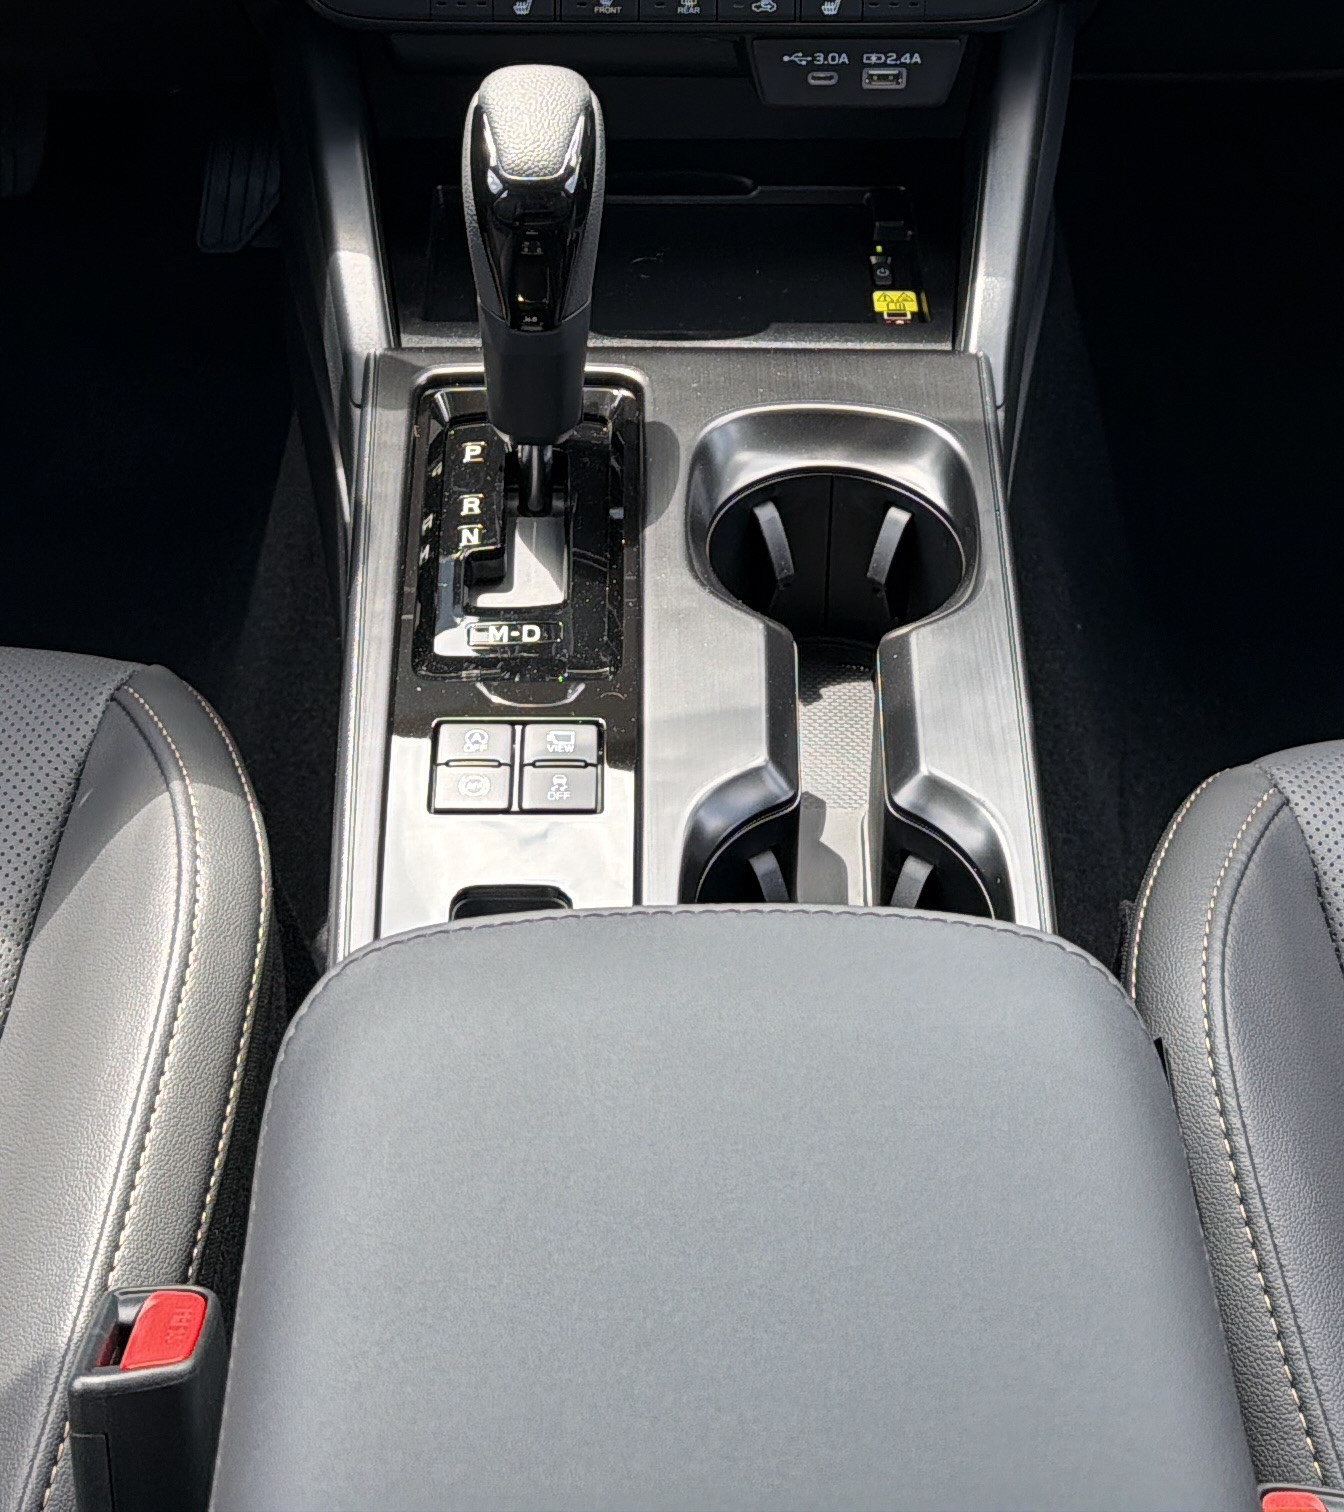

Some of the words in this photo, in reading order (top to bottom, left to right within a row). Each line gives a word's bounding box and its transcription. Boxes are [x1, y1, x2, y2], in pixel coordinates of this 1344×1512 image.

[594, 6, 622, 14] FRONT
[677, 6, 701, 15] REAR
[814, 52, 849, 65] 3.0A
[886, 52, 922, 65] 2.4A
[463, 445, 484, 463] P
[461, 498, 481, 516] R
[459, 529, 481, 547] N
[463, 744, 488, 753] OFF
[547, 744, 575, 753] VIEW
[547, 791, 572, 801] OFF
